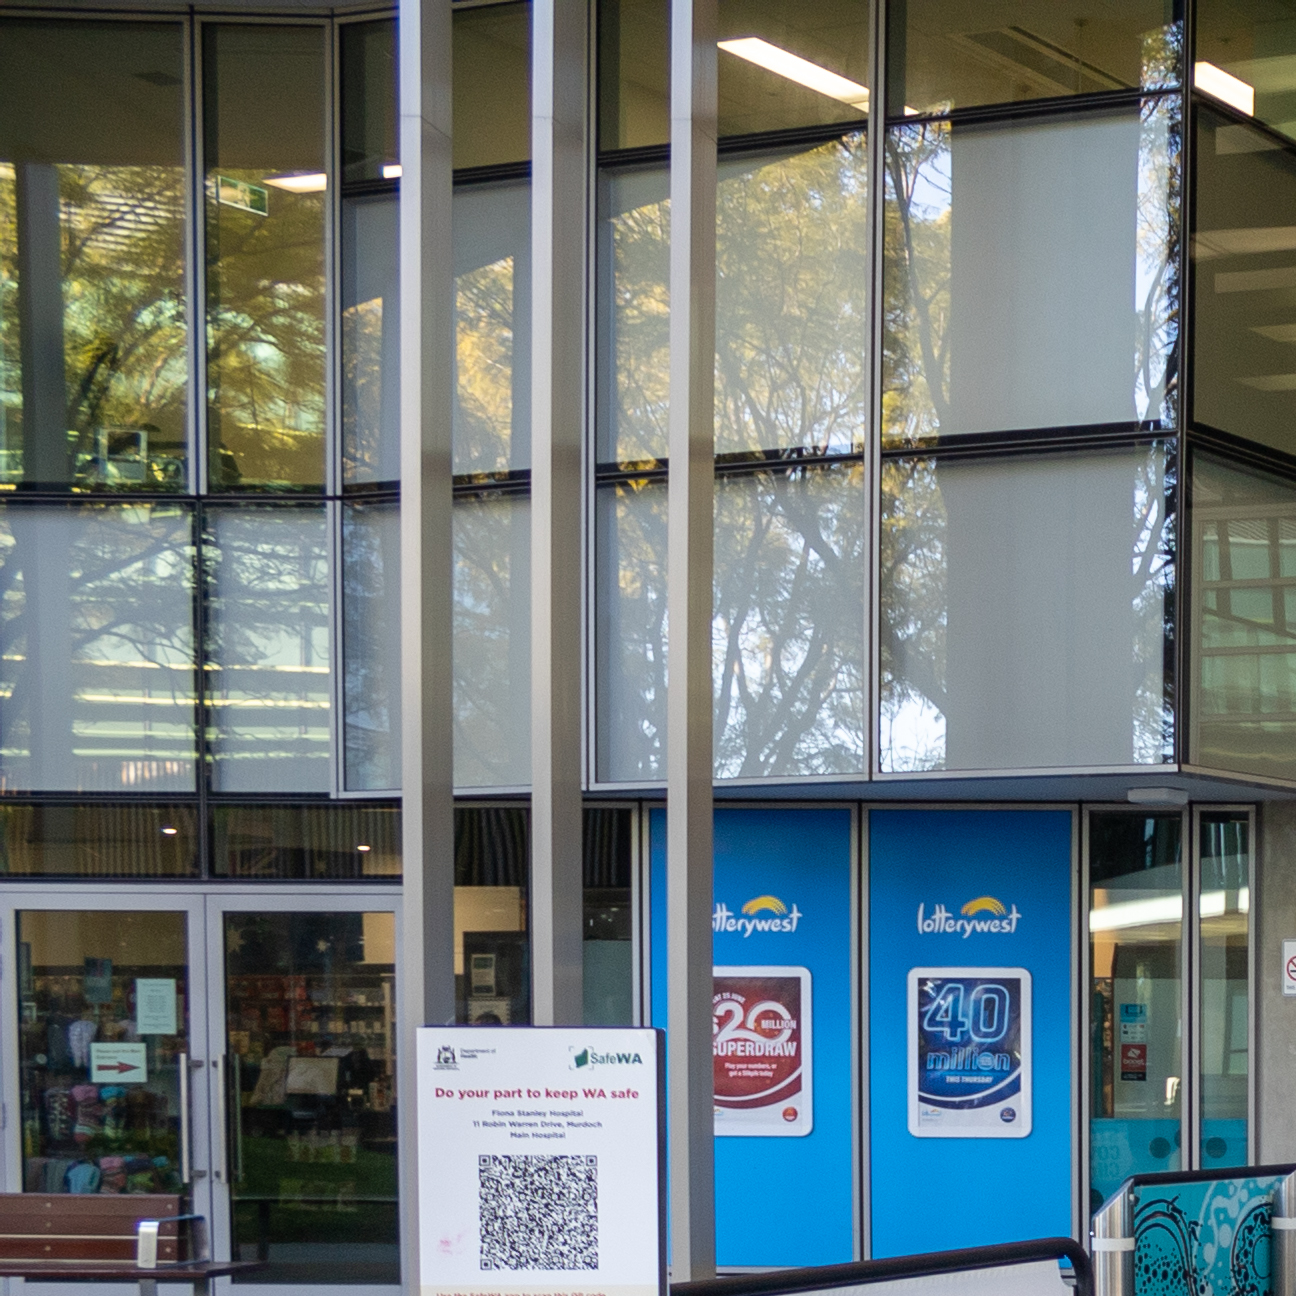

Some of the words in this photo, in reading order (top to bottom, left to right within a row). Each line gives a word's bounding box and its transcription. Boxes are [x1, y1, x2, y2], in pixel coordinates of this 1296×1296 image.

[712, 904, 802, 938] tterywest
[918, 902, 1022, 939] lotterywest
[923, 983, 1010, 1043] 40
[762, 1020, 796, 1029] MILLION
[590, 1052, 642, 1065] SafeWA
[927, 1046, 1010, 1070] million
[435, 1087, 454, 1098] Do
[458, 1089, 489, 1100] your
[494, 1089, 522, 1100] part
[527, 1089, 541, 1098] to
[546, 1088, 578, 1100] keep
[583, 1088, 606, 1098] WA
[611, 1088, 639, 1099] safe
[517, 1110, 546, 1118] Stanley
[550, 1110, 583, 1118] Hospital
